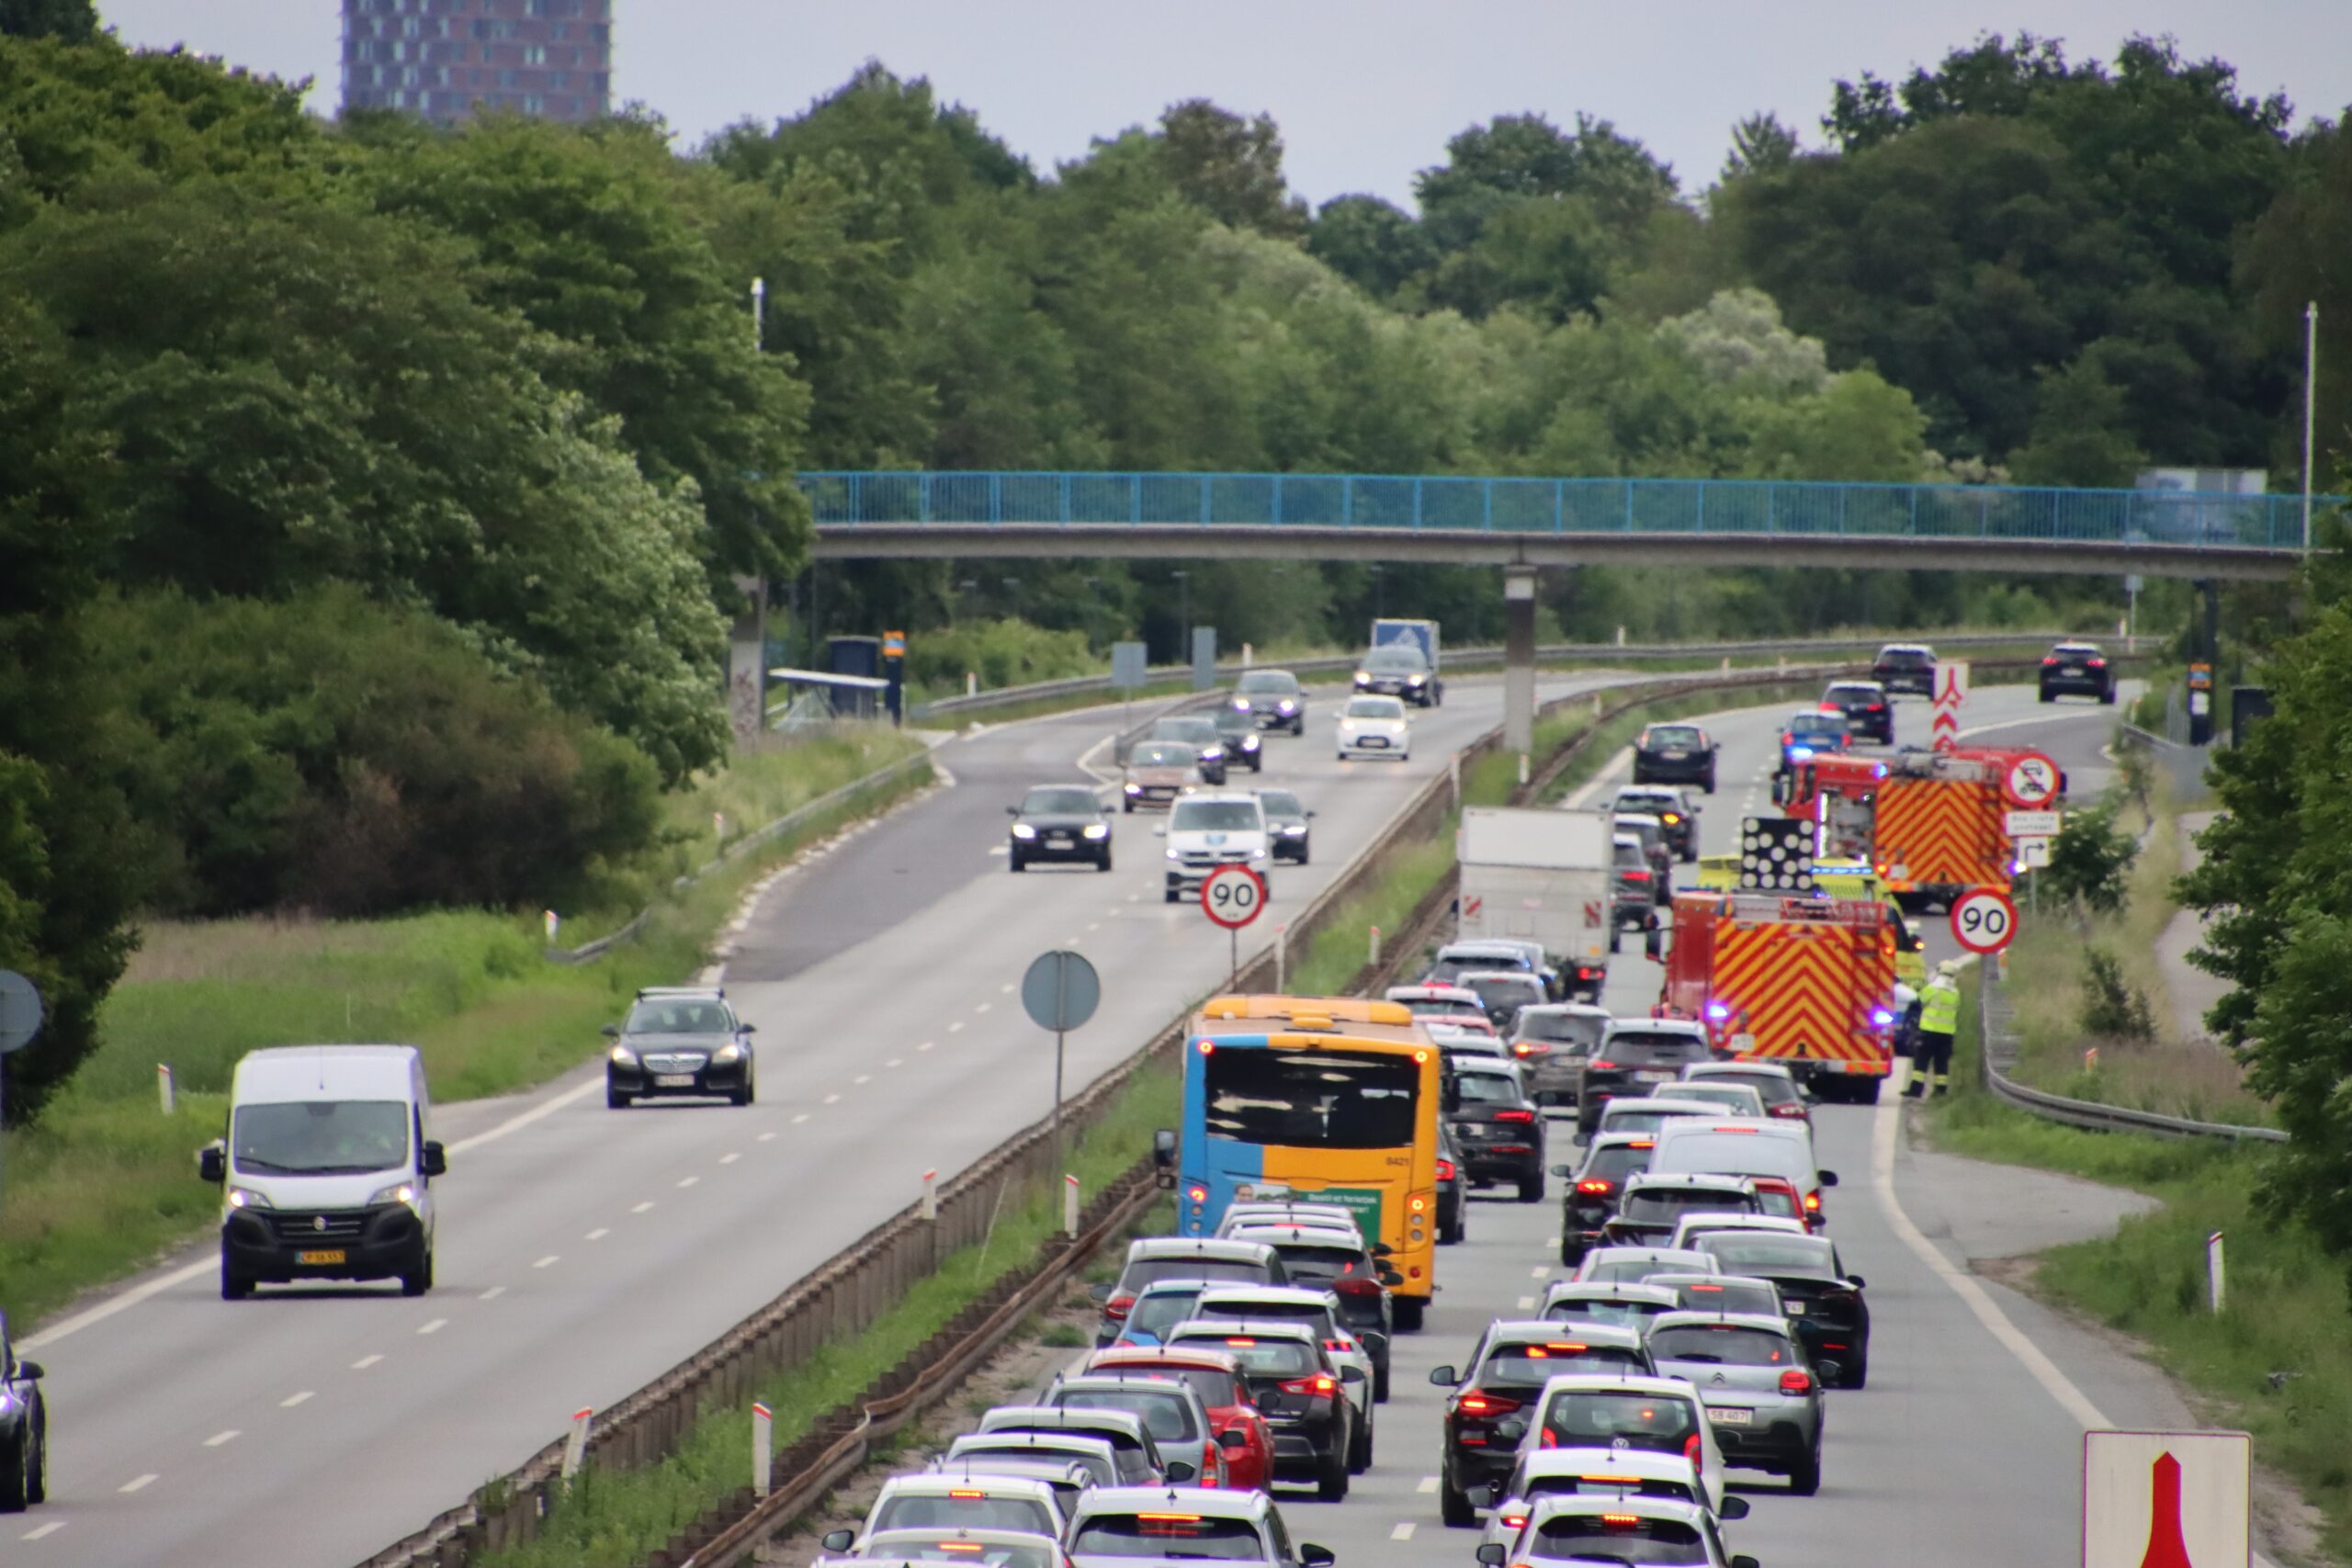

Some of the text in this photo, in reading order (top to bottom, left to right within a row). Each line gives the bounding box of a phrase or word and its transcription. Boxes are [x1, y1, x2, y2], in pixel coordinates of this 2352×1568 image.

[1214, 883, 1252, 907] 90
[1963, 907, 2005, 934] 90
[1385, 1156, 1410, 1166] 8421
[1727, 1411, 1746, 1421] 407
